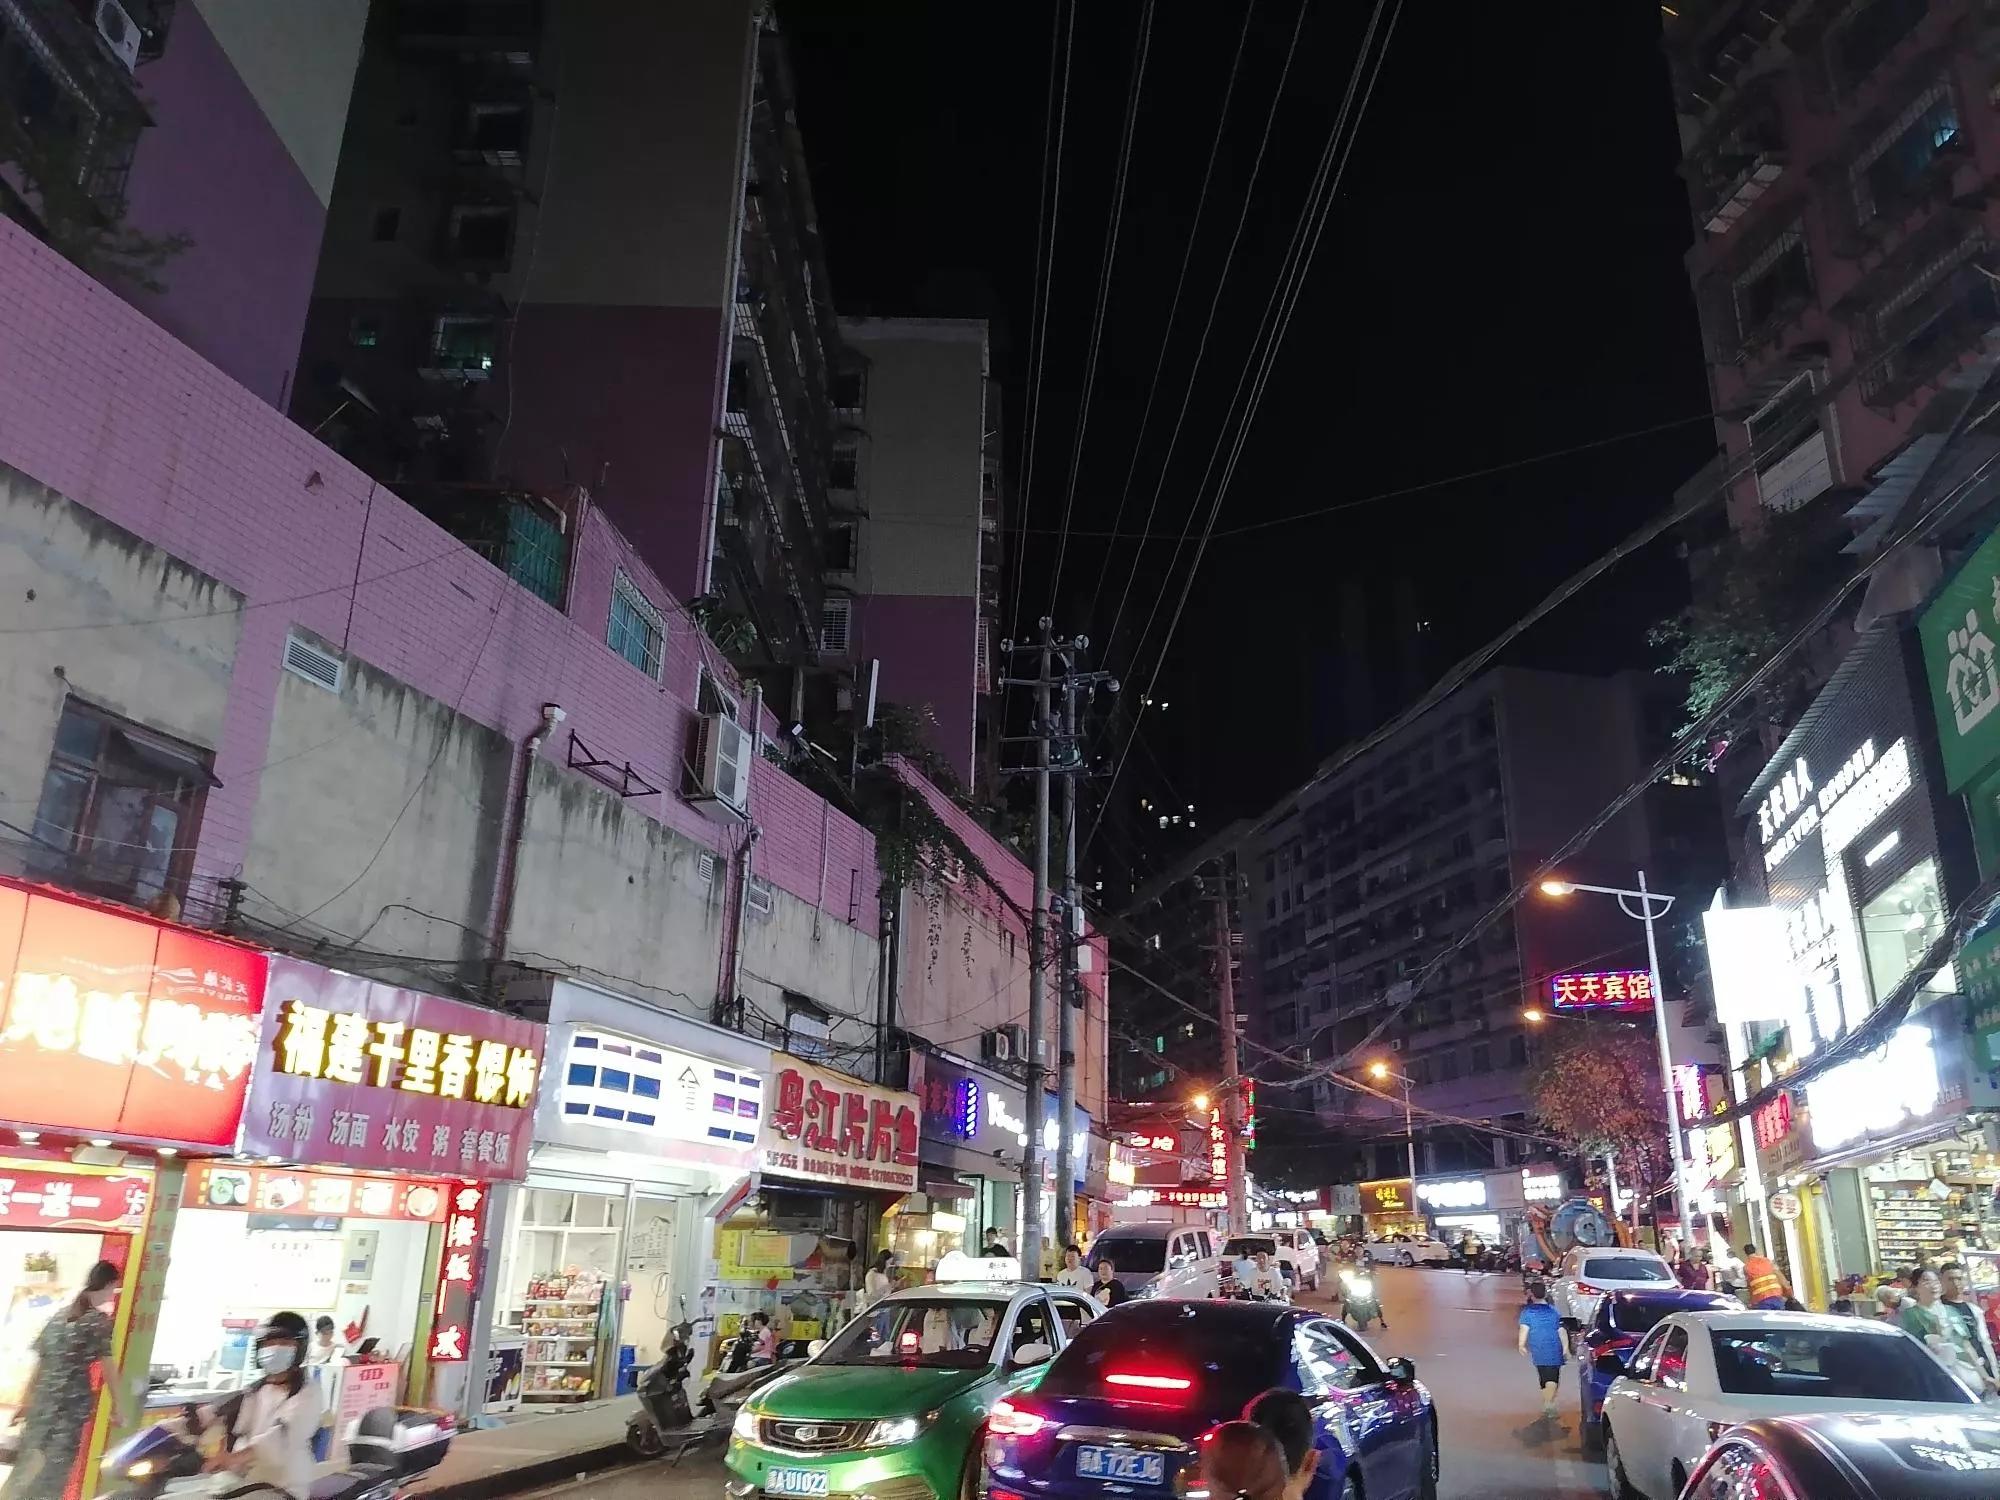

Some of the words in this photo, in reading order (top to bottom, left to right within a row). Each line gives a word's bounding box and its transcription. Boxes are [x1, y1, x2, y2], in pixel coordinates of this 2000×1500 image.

[1557, 973, 1650, 1003] 天天宾馆
[280, 999, 538, 1108] 福建千里香馄饨
[269, 1100, 315, 1140] 汤粉
[329, 1108, 370, 1148] 汤面
[381, 1115, 421, 1153] 水饺
[431, 1123, 451, 1158] 粥
[460, 1126, 511, 1164] 套餐饭
